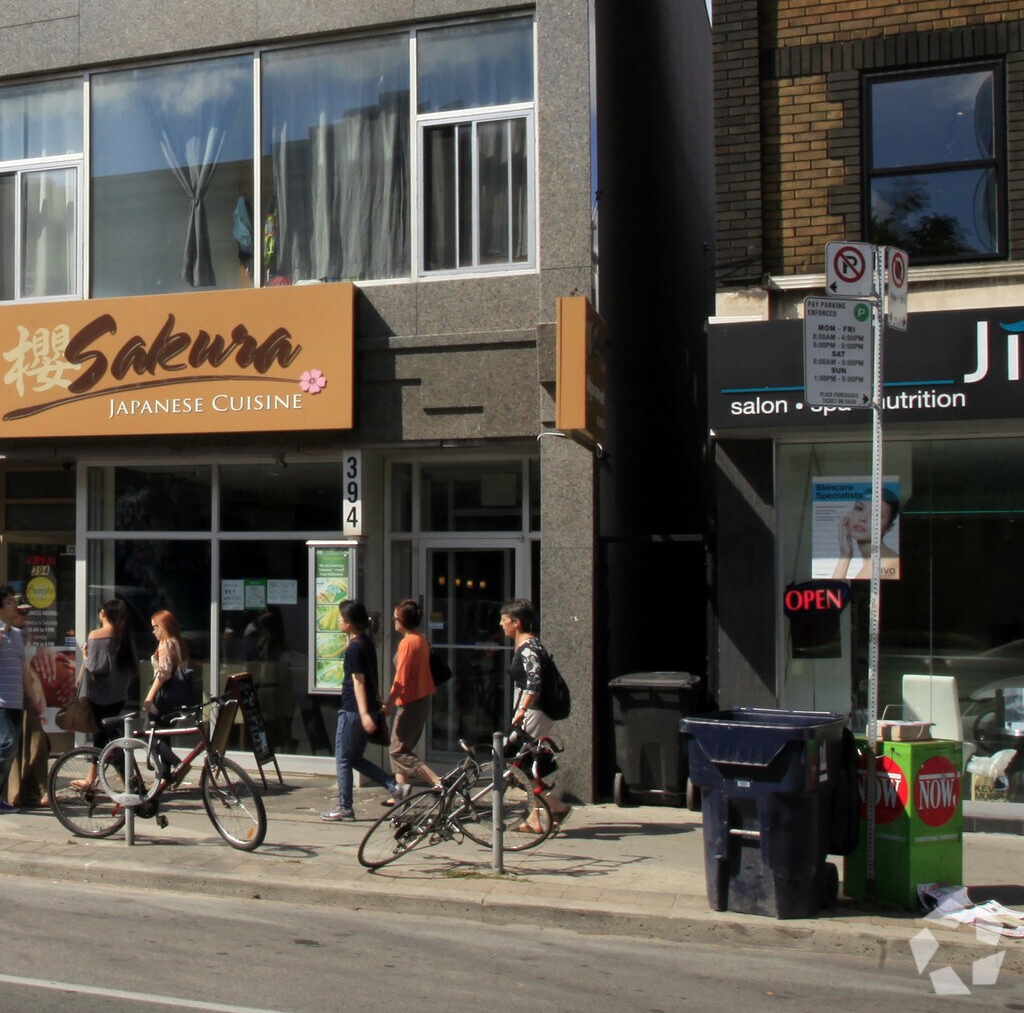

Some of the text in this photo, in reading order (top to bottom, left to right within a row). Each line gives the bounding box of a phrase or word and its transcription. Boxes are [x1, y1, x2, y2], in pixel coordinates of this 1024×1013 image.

[820, 301, 846, 309] PARKING
[807, 308, 837, 317] ENFORCED
[817, 324, 836, 332] MON
[842, 325, 856, 333] FRI
[64, 312, 302, 393] Sakura
[109, 393, 303, 420] JAPANESE CUISINE
[731, 396, 788, 416] salon
[346, 456, 358, 528] 394
[816, 484, 854, 492] Skincare
[816, 491, 863, 500] Specialists
[32, 566, 50, 576] 394
[785, 590, 842, 611] OPEN
[919, 778, 955, 810] NOW
[975, 792, 1010, 801] MURPH
